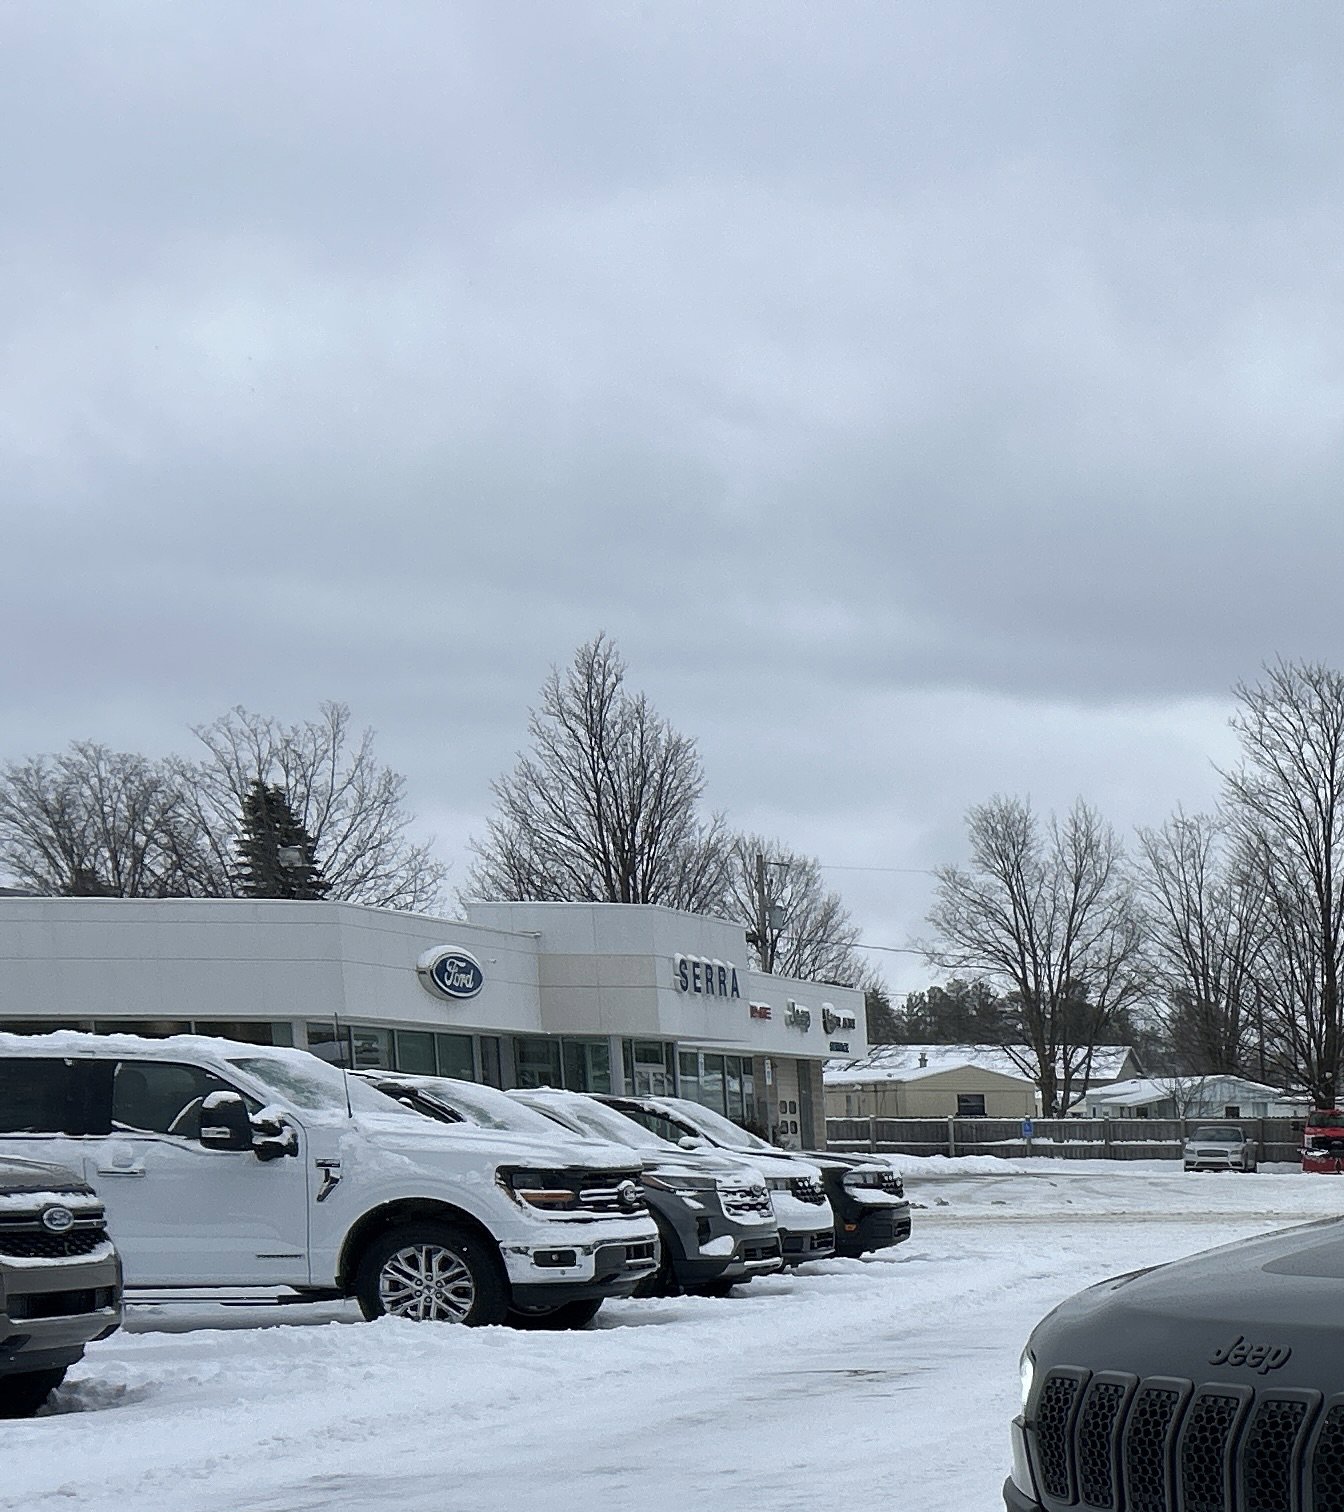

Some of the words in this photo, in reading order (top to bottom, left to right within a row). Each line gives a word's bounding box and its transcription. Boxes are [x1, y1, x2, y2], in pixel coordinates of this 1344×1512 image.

[444, 958, 474, 988] Ford
[677, 957, 741, 999] SERRA
[1208, 1335, 1293, 1375] Jeep
